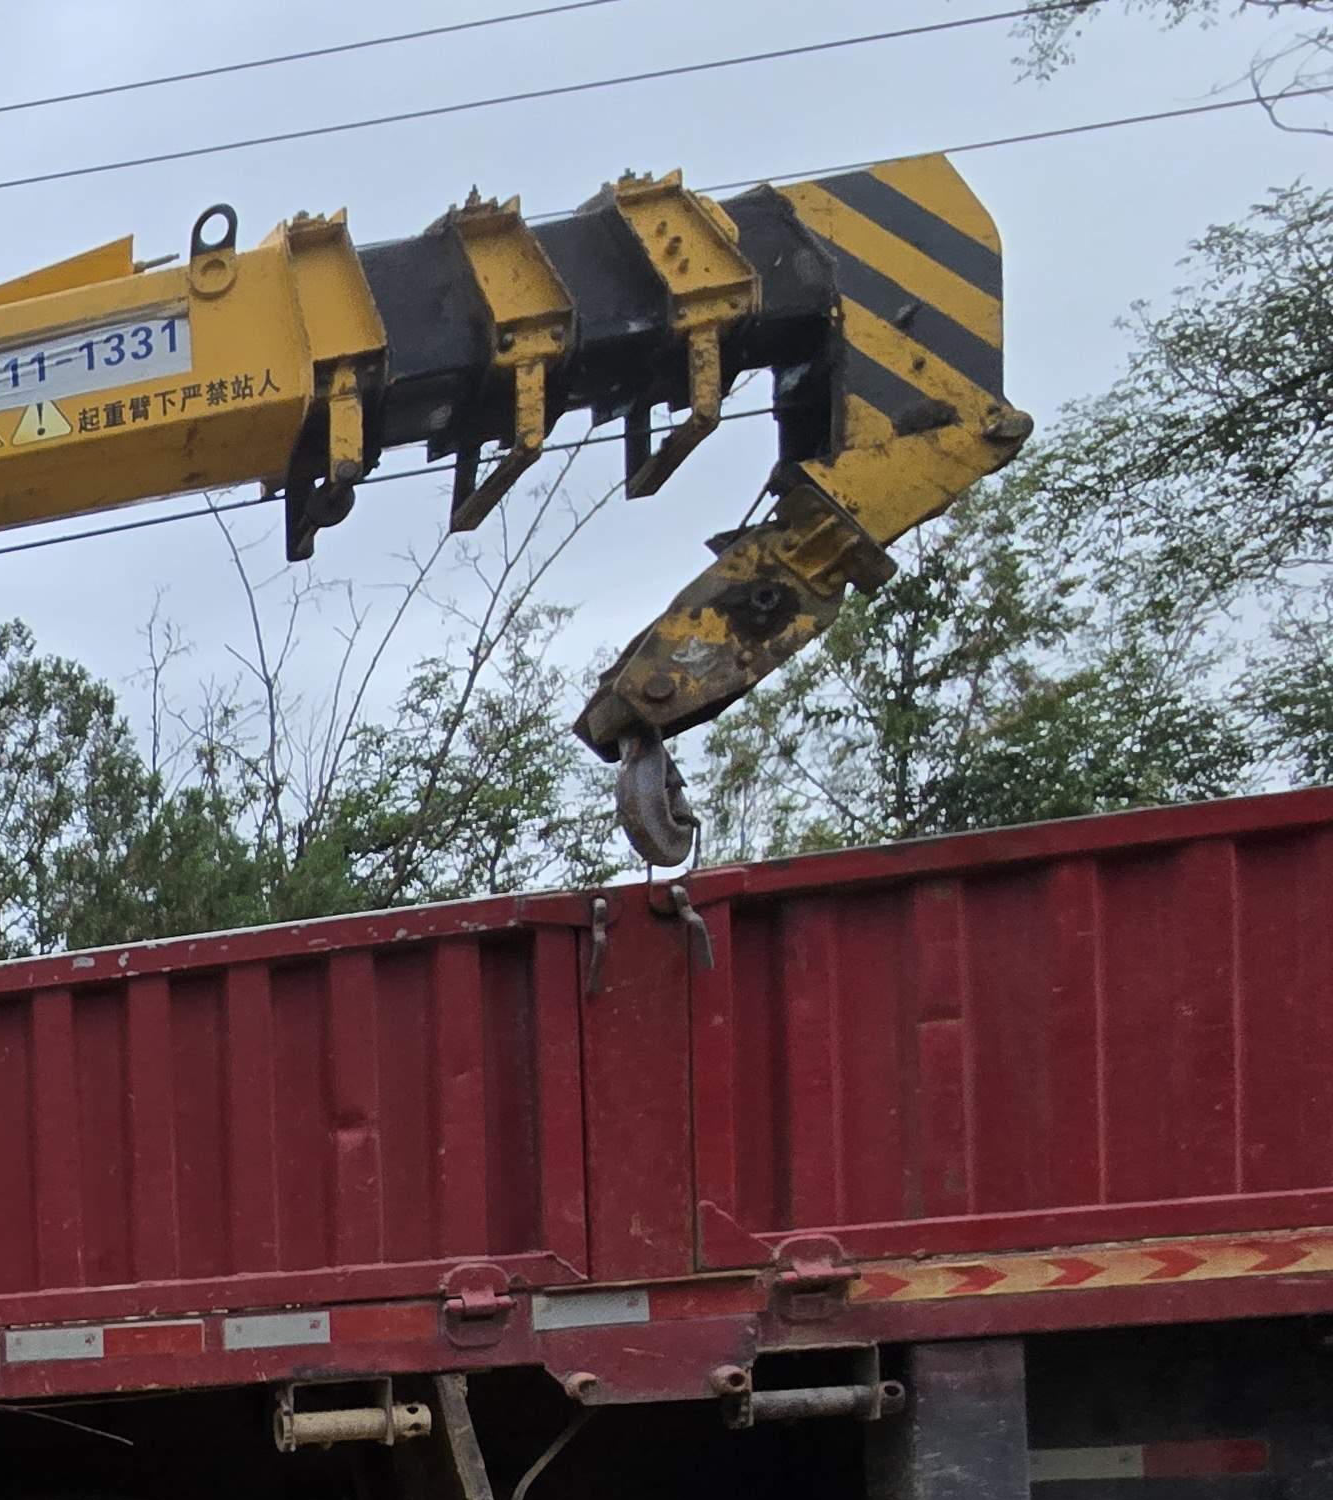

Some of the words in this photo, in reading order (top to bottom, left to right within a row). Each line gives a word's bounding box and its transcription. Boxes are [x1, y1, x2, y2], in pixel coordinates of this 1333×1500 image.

[77, 368, 282, 434] 起重臂下严禁站人
